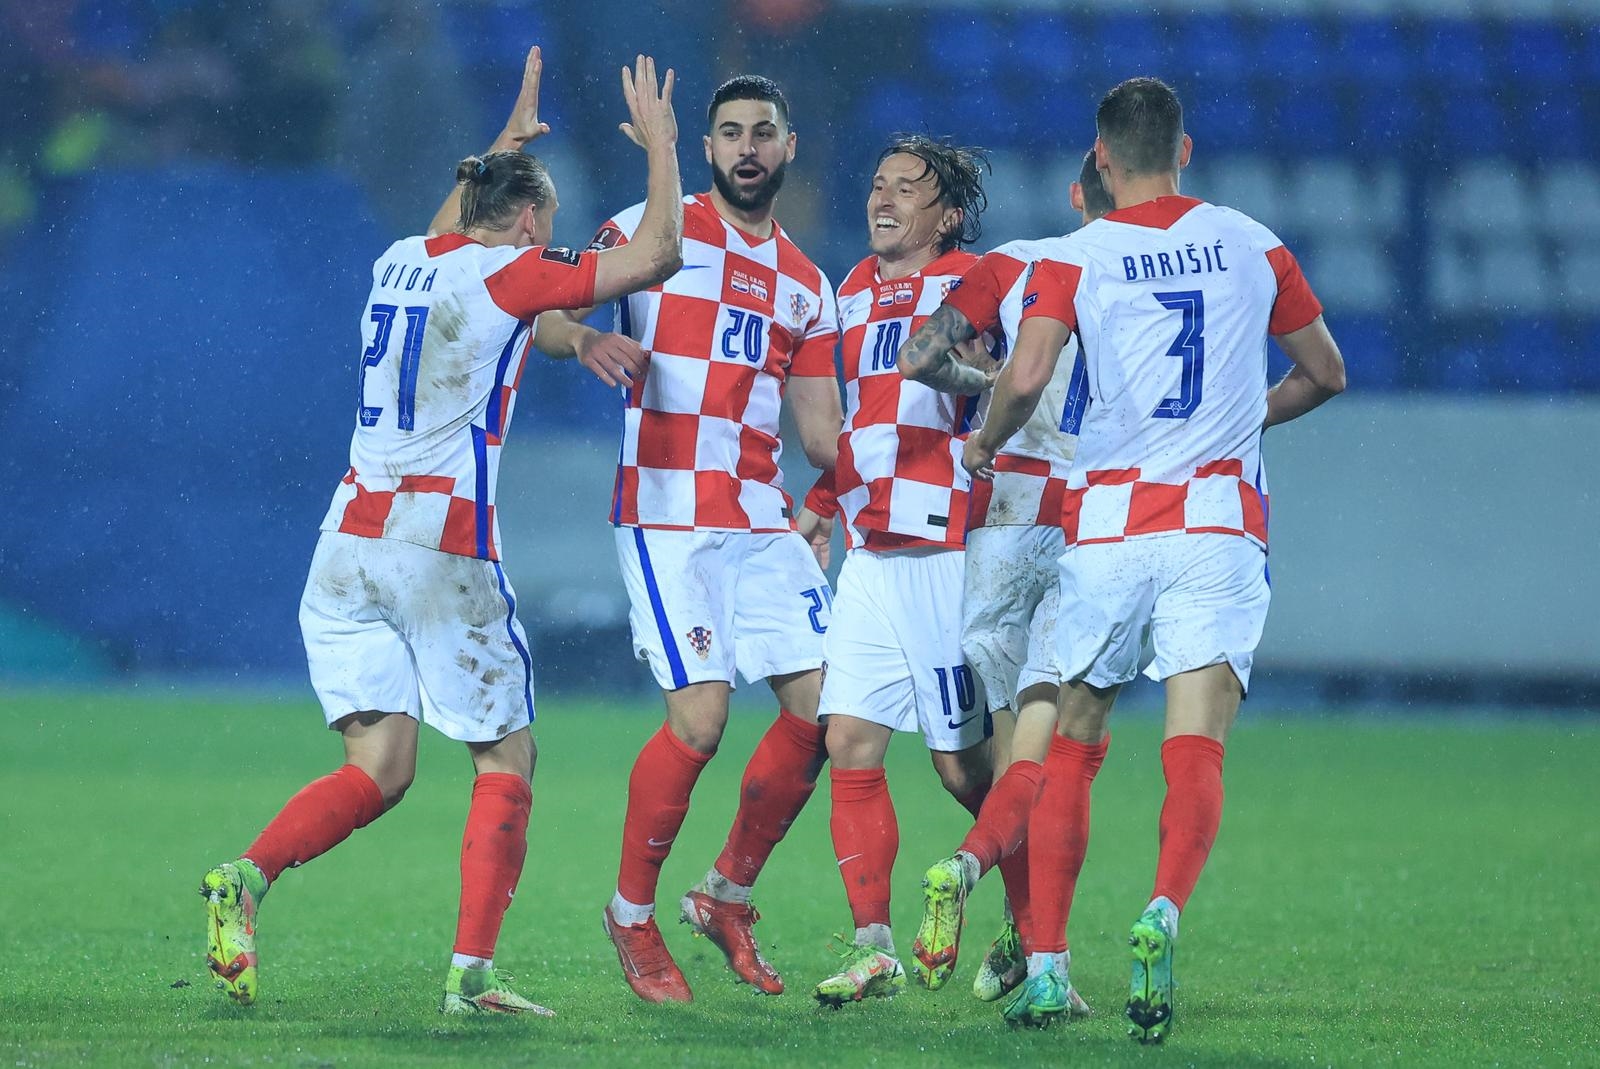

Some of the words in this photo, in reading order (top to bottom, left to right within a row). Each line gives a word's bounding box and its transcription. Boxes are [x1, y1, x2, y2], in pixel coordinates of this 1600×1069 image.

[382, 263, 437, 292] VIDA
[1123, 240, 1228, 280] BARIŠIĆ
[721, 309, 763, 363] 20
[872, 321, 902, 371] 10
[1152, 290, 1205, 419] 3
[359, 304, 429, 431] 21
[933, 664, 976, 716] 10
